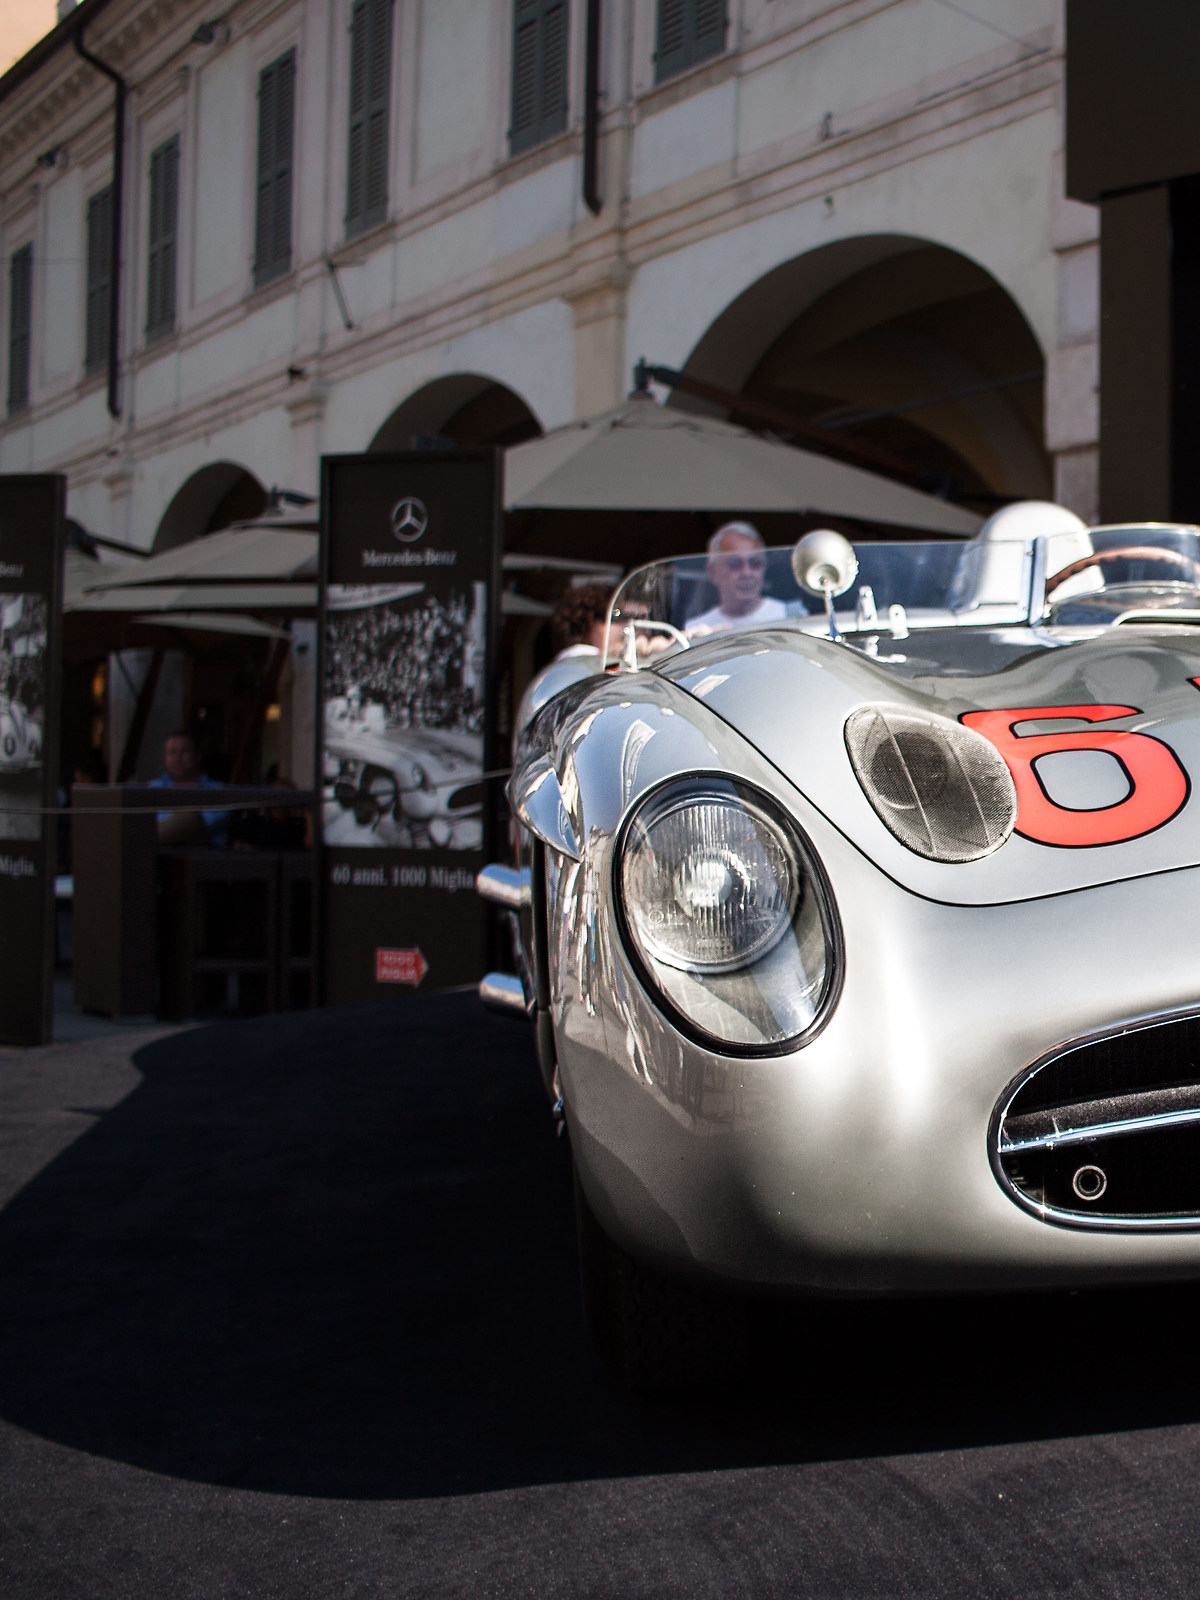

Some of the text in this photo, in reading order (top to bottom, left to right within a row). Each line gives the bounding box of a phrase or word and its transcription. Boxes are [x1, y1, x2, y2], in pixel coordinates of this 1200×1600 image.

[361, 548, 458, 567] Mercedes-Benz
[332, 863, 351, 885] 60
[352, 865, 388, 887] anni.
[392, 865, 427, 888] 1000
